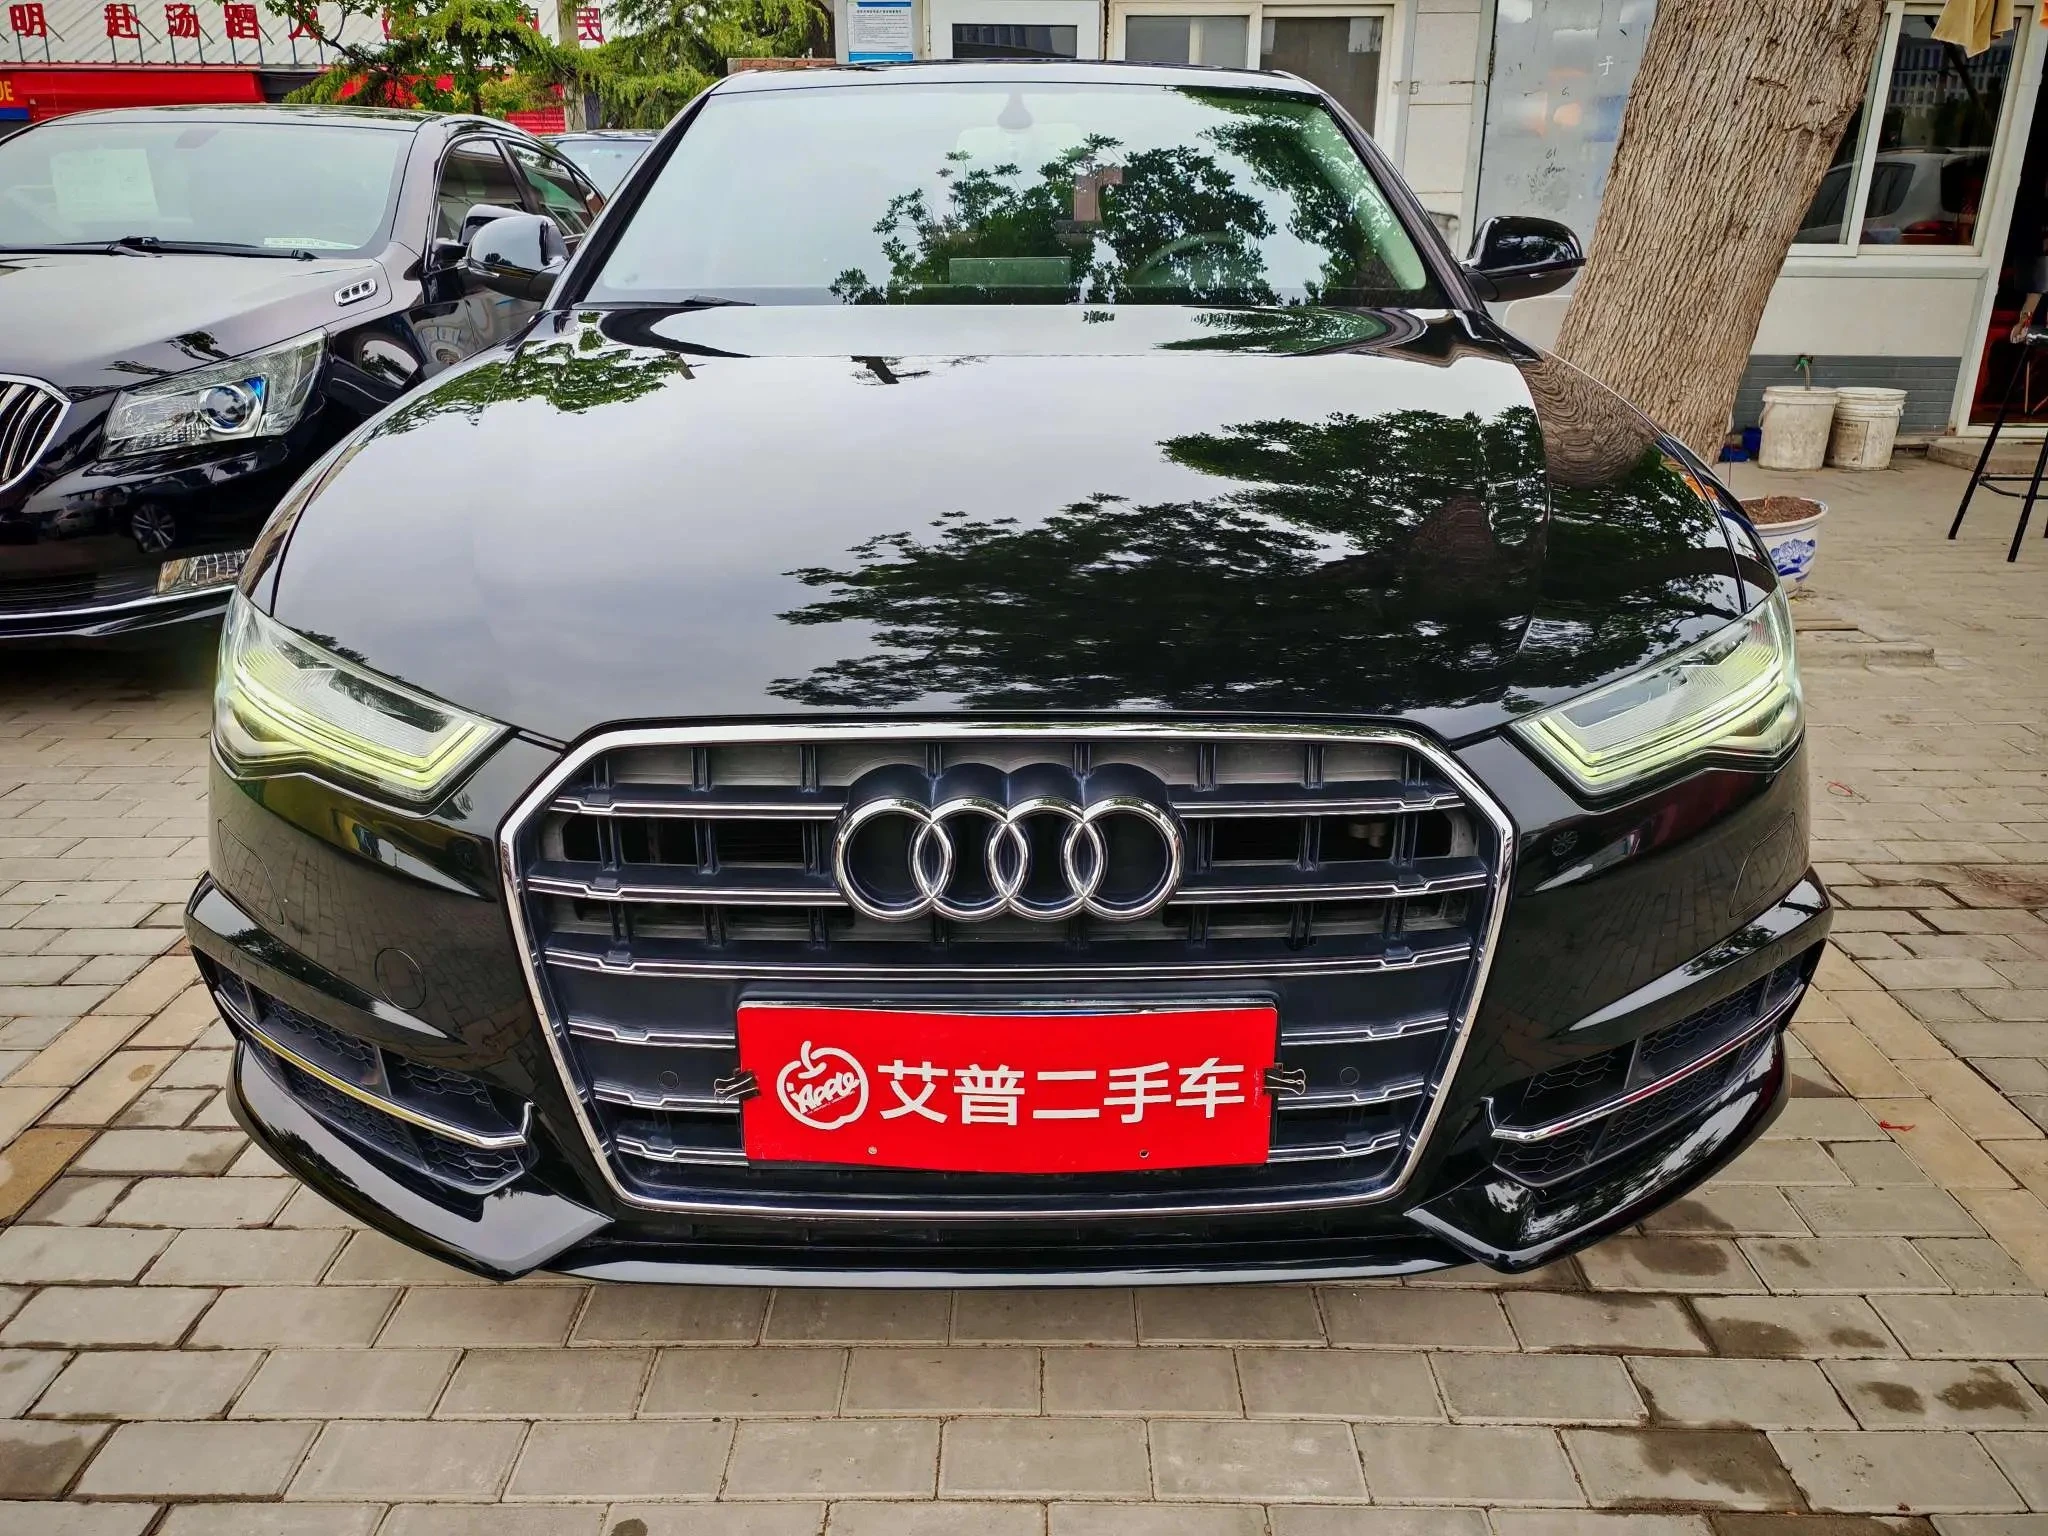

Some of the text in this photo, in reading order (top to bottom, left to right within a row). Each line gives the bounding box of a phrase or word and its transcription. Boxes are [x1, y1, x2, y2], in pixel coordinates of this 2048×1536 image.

[9, 3, 47, 37] 明
[878, 1058, 1245, 1126] 艾普二手车
